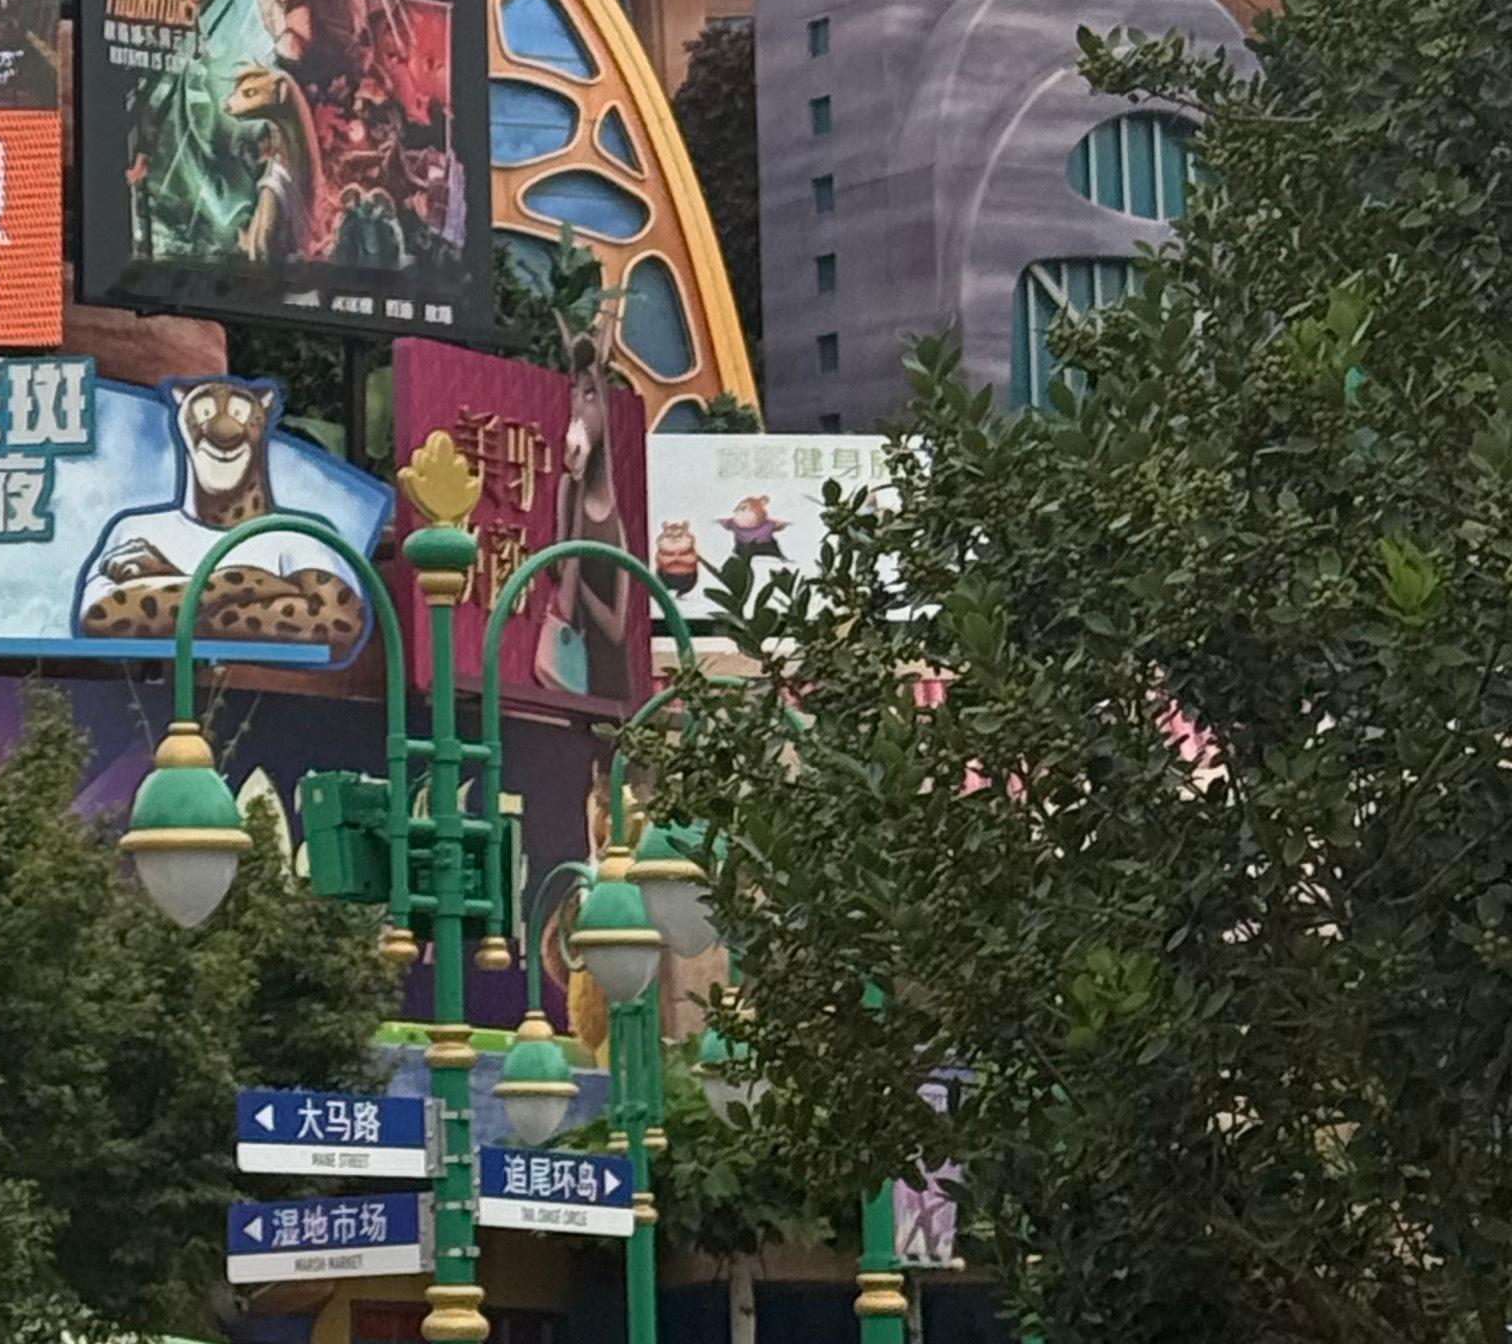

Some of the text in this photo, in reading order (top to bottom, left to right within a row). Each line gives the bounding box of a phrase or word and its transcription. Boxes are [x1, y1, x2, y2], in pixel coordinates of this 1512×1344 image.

[297, 1097, 381, 1144] 大马路
[503, 1154, 598, 1202] 追尾环岛
[271, 1201, 387, 1248] 湿地市场
